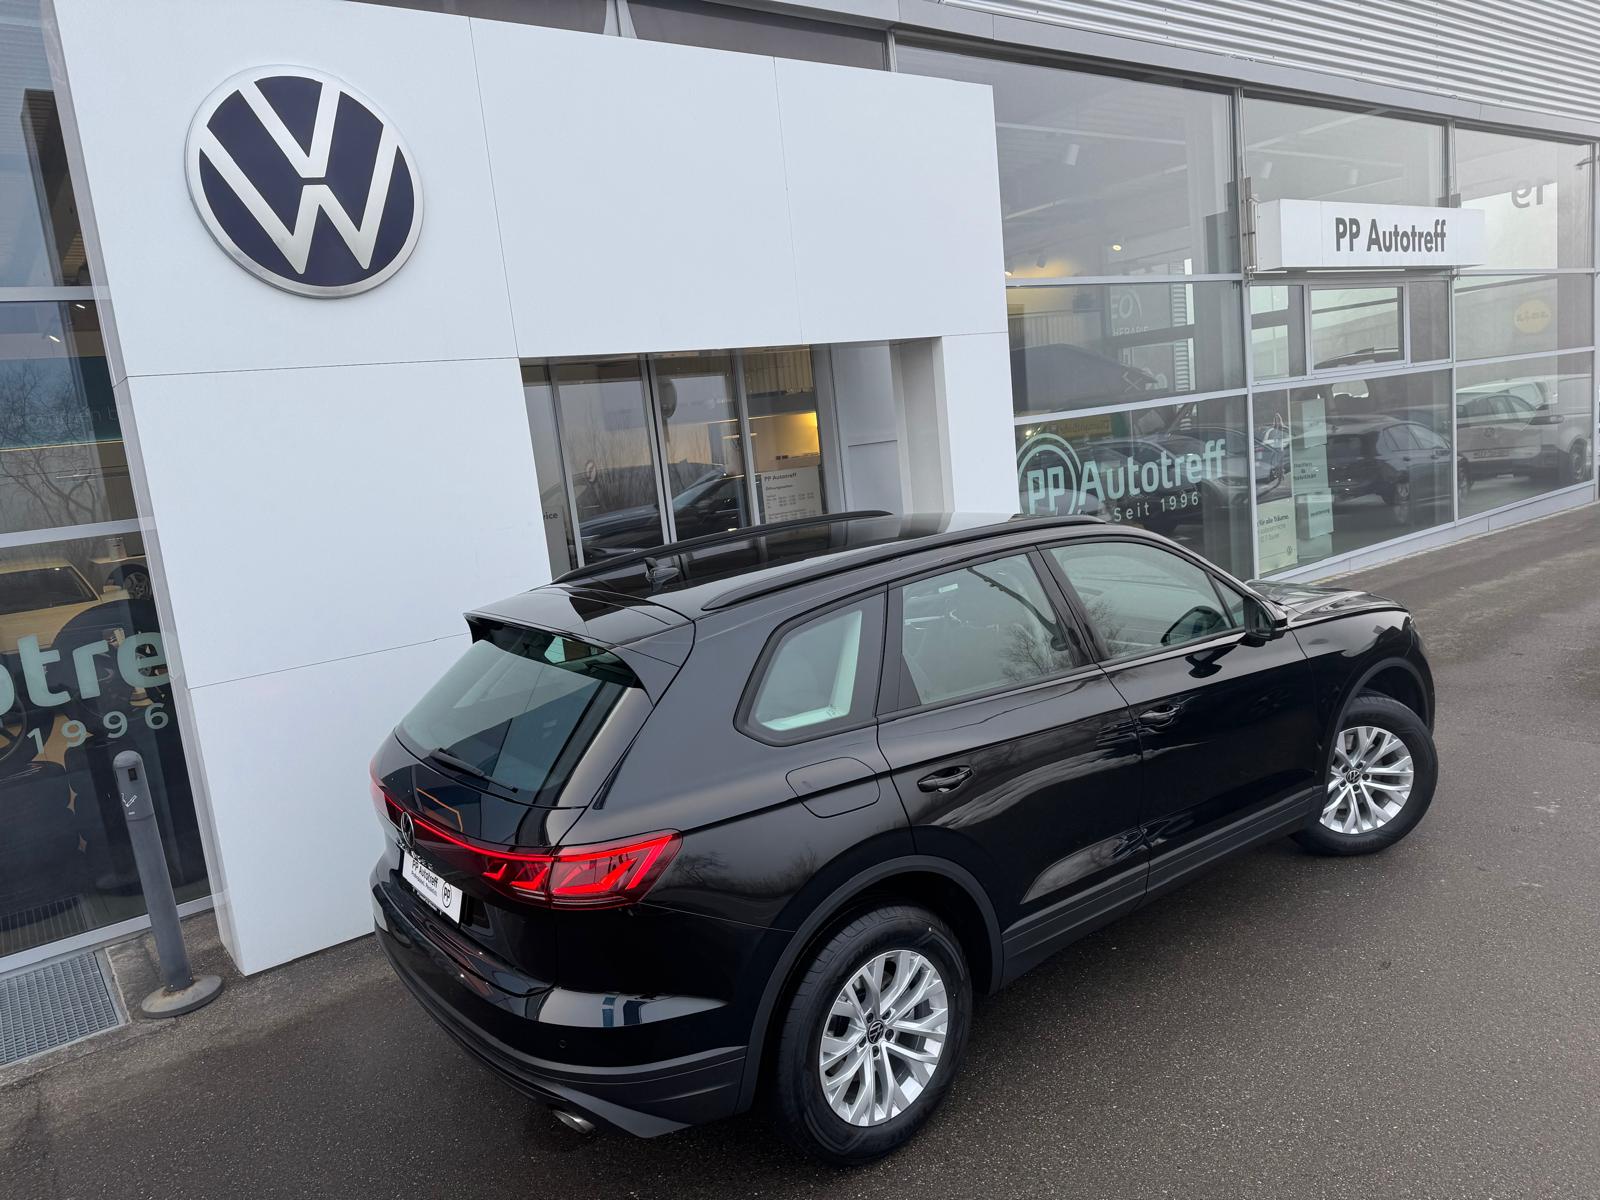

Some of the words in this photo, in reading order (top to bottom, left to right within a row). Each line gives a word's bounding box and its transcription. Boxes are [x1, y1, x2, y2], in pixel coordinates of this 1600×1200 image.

[1335, 217, 1361, 252] PP
[1366, 218, 1447, 252] Autotreff
[1027, 466, 1065, 514] PP
[1079, 439, 1226, 505] Autotreff
[1113, 503, 1150, 522] Seit
[1160, 491, 1200, 512] 1996
[27, 702, 169, 754] 1996
